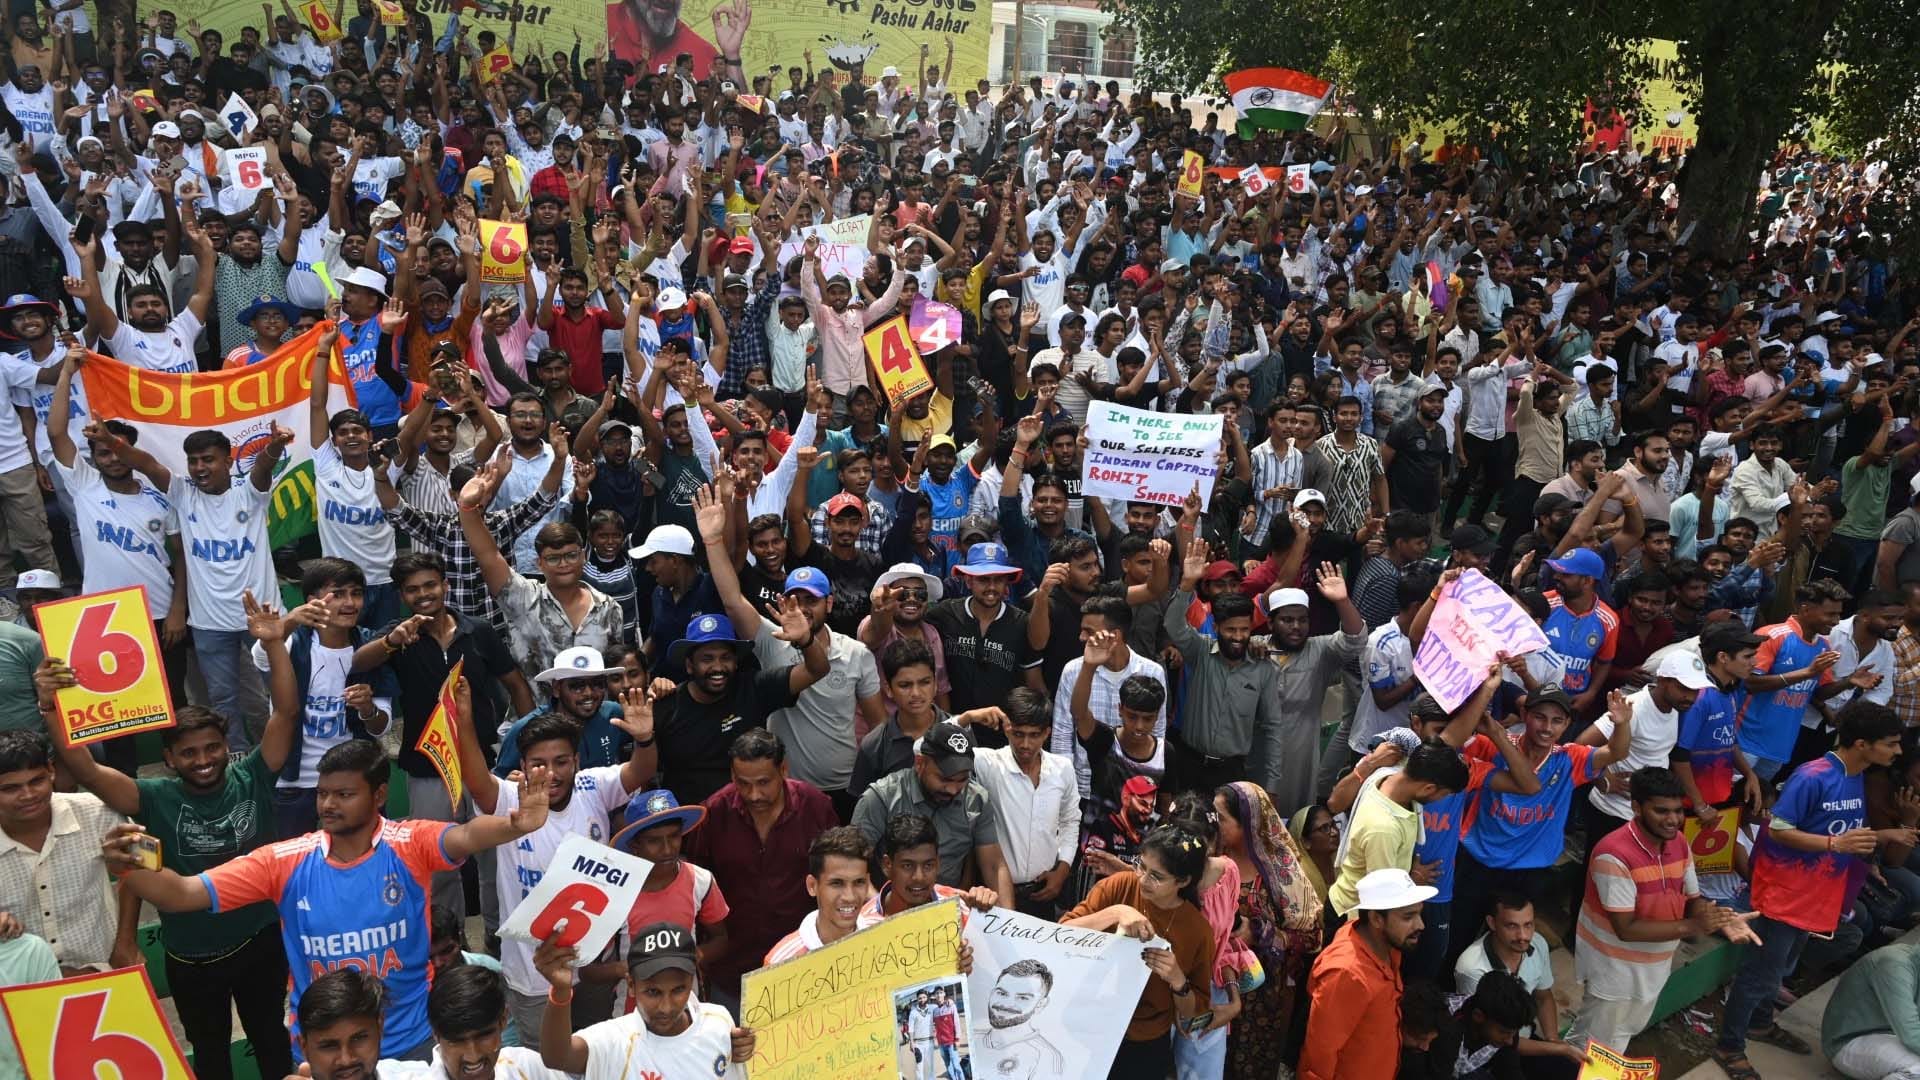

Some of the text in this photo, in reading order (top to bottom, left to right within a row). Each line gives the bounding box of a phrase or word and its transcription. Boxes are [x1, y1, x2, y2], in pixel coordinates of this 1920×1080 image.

[309, 5, 329, 31] 6
[871, 4, 918, 29] Pashu
[921, 10, 970, 35] Aahar
[238, 160, 263, 189] 6
[1187, 156, 1201, 184] 6
[1247, 174, 1263, 193] 6
[1290, 172, 1304, 192] 6
[831, 219, 864, 234] VIRAT
[490, 226, 522, 265] 6
[792, 242, 850, 263] VRAT
[919, 318, 951, 352] 4
[881, 325, 913, 374] 4
[1108, 410, 1219, 432] IM HERE ONLY
[1132, 429, 1184, 441] TO SEE
[1100, 440, 1204, 458] OUR SELFLESS
[1089, 466, 1148, 485] ROHIT
[1090, 452, 1218, 477] INDIAN CAPTAIN
[325, 500, 386, 527] INDIA
[69, 602, 145, 693] 6
[68, 701, 163, 729] DKG Mobiles
[79, 724, 119, 737] Multibrand
[120, 719, 144, 728] Mobile
[145, 714, 167, 723] Outlet
[1423, 812, 1450, 832] DIA
[1691, 816, 1730, 857] 6
[572, 855, 630, 887] MPGI
[530, 882, 610, 948] 6
[301, 919, 407, 957] DREAM11
[644, 929, 681, 953] BOY
[983, 914, 1105, 948] Virat Kohli
[53, 991, 164, 1080] 6
